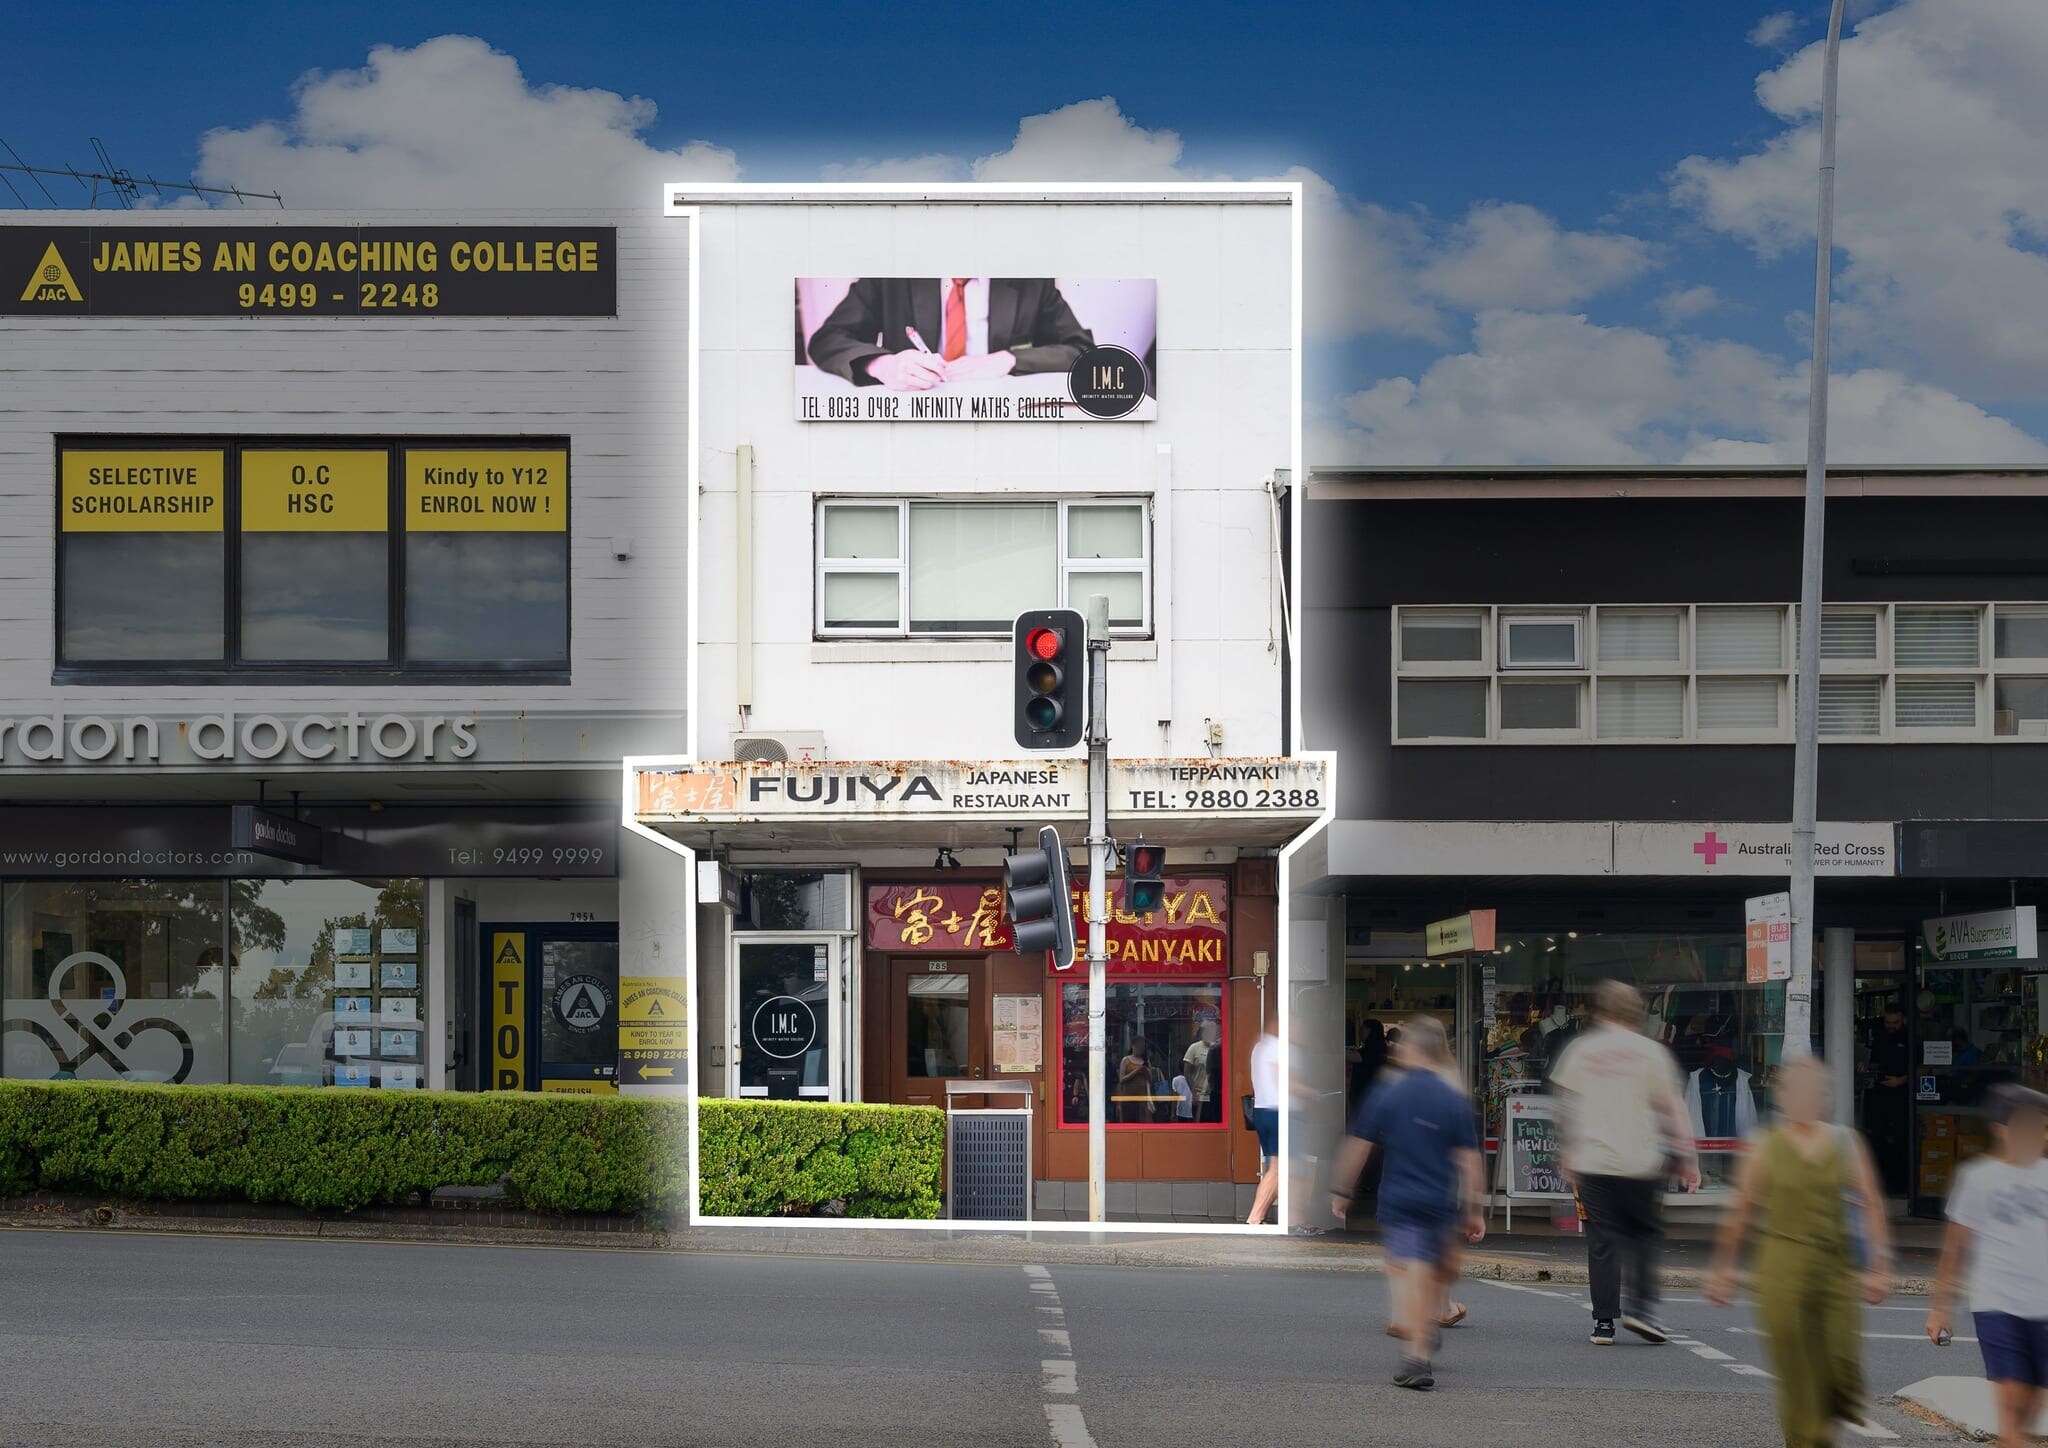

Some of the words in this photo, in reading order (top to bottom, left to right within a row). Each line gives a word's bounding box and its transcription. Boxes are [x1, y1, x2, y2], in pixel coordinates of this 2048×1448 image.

[93, 241, 202, 272] JAMES
[213, 241, 257, 272] AN
[268, 241, 438, 272] COACHING
[450, 241, 599, 272] COLLEGE
[37, 288, 66, 301] JAC
[239, 283, 317, 308] 9499
[361, 283, 440, 308] 2248
[1093, 366, 1125, 390] I.M.C
[801, 396, 821, 419] TEL
[829, 396, 860, 419] 8033
[867, 396, 899, 419] 0482
[911, 396, 964, 419] INFINITY
[971, 396, 1010, 419] MATHS
[1017, 396, 1065, 419] COLLEGE
[88, 467, 198, 486] SELECTIVE
[291, 465, 331, 487] O.C
[424, 467, 479, 490] Kindy
[485, 469, 505, 486] to
[512, 468, 548, 486] Y12
[71, 494, 215, 515] SCHOLARSHIP
[287, 494, 334, 514] HSC
[420, 495, 486, 513] ENROL
[492, 495, 538, 513] NOW
[188, 711, 478, 761] doctors
[965, 770, 1059, 785] JAPANESE
[1170, 766, 1280, 781] TEPPANYAKI
[750, 775, 942, 806] FUJIYA
[1129, 790, 1177, 810] TEL:
[1184, 790, 1249, 808] 9880
[1255, 788, 1320, 808] 2388
[953, 793, 1071, 809] RESTAURANT
[255, 819, 276, 841] gordon
[276, 823, 297, 847] doctors
[3, 849, 254, 868] www.gordondoctors.com
[448, 848, 484, 864] Tel:
[493, 848, 544, 864] 9499
[552, 848, 603, 864] 9999
[1738, 842, 1792, 855] Australi
[1814, 842, 1839, 856] Red
[1844, 842, 1885, 856] Cross
[570, 912, 595, 921] 795A
[895, 888, 1007, 947] 富士屋
[1753, 929, 1762, 938] NO
[1770, 933, 1788, 941] ZONE
[1771, 924, 1788, 933] BUS
[1949, 919, 1971, 945] AVA
[1970, 924, 2012, 945] Supermarket
[503, 956, 515, 964] JAC
[1074, 940, 1222, 962] EPANYAKI
[553, 981, 571, 1006] JAMES
[571, 975, 583, 984] AN
[585, 976, 614, 1007] COLLEGE
[622, 991, 638, 1008] JAMES
[638, 988, 646, 998] AN
[646, 987, 672, 998] COACHING
[575, 1011, 592, 1019] JAC
[771, 1013, 797, 1034] I.M.C
[639, 1038, 659, 1046] ENROL
[660, 1038, 673, 1046] NOW
[634, 1051, 660, 1059] 9499
[663, 1051, 688, 1059] 2248
[1517, 1120, 1544, 1140] Find
[1517, 1139, 1542, 1151] NEW
[1528, 1151, 1561, 1164] here
[1522, 1165, 1552, 1176] Come
